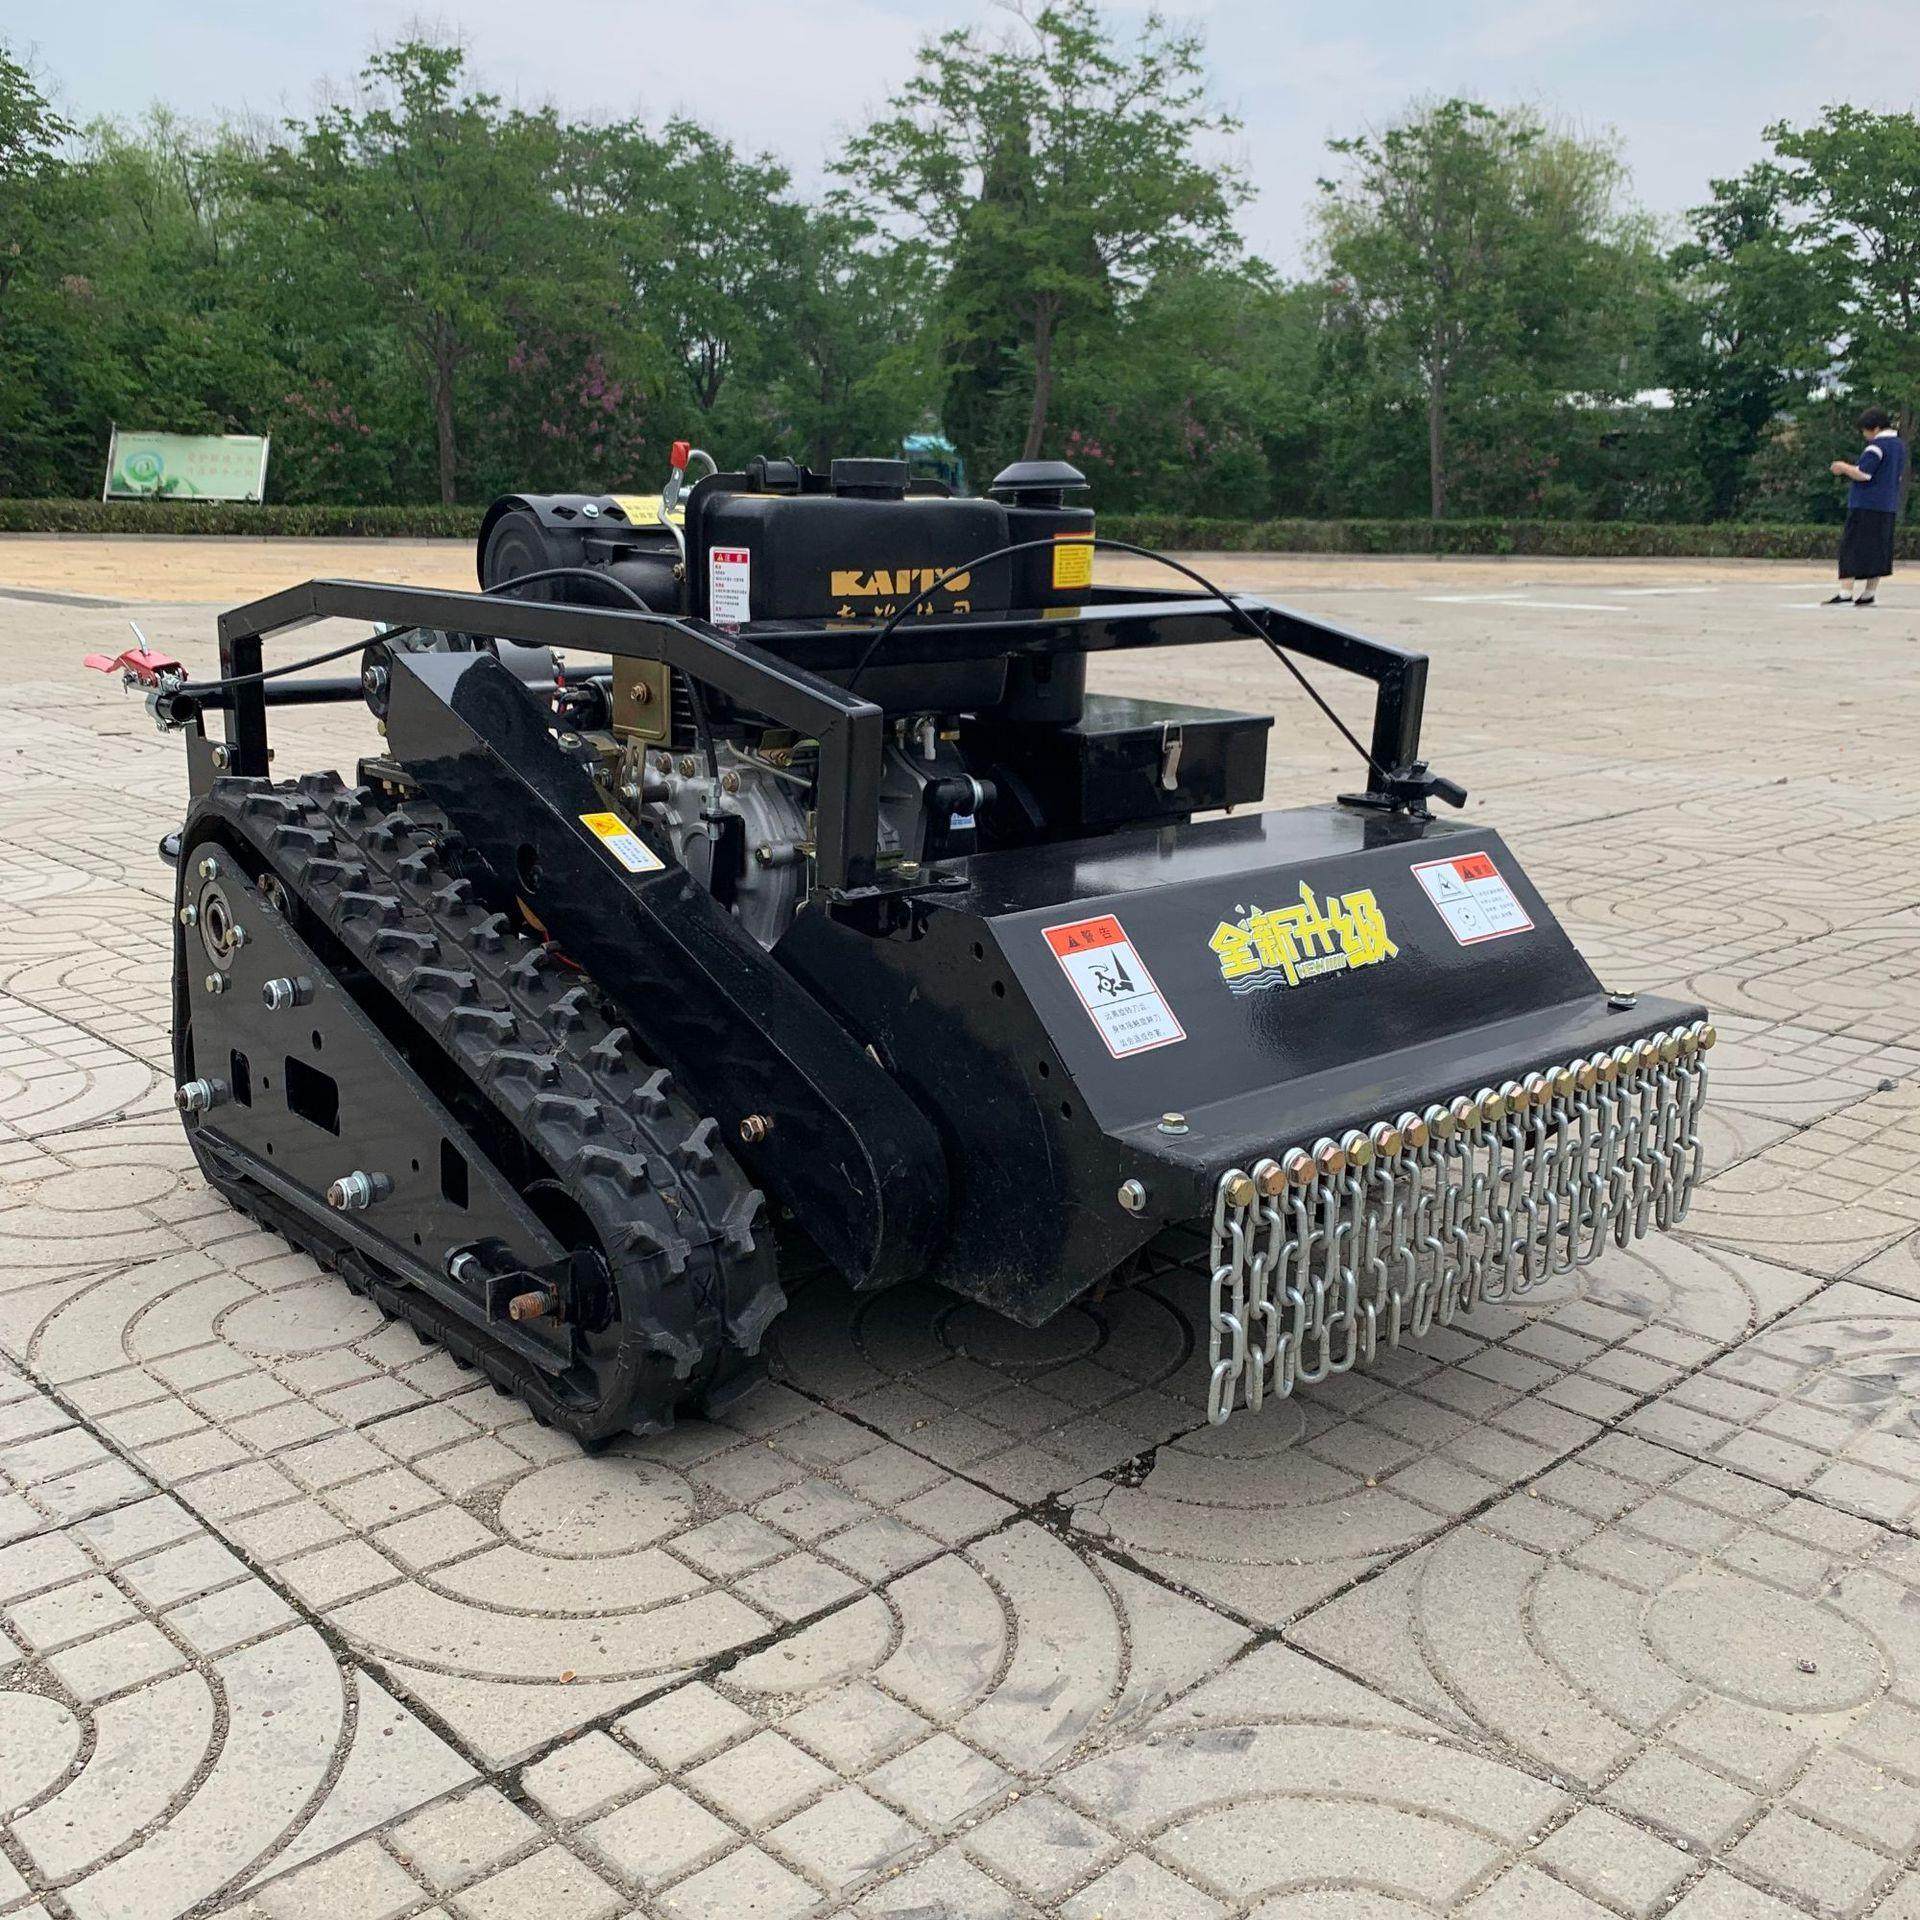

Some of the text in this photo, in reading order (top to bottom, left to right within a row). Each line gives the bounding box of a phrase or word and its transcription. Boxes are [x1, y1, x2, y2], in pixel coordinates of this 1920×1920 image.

[1080, 926, 1112, 944] 警告
[1208, 880, 1399, 986] 全新升级
